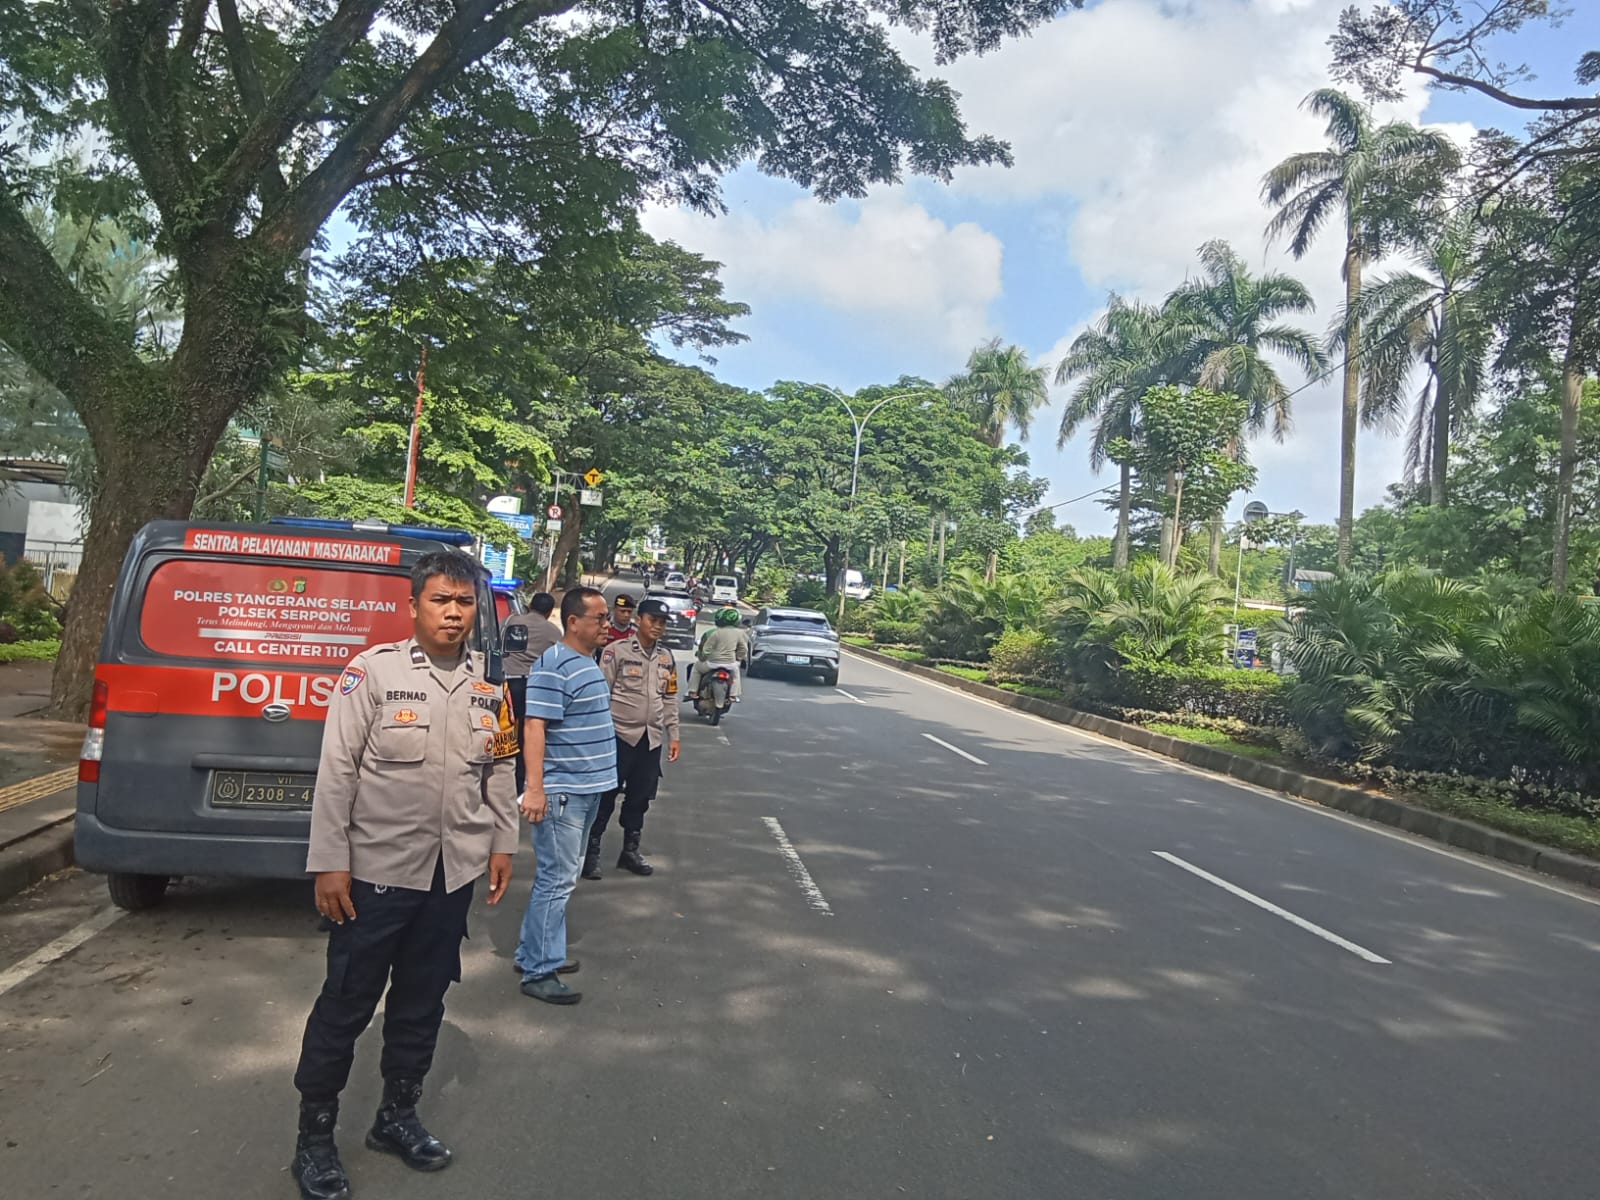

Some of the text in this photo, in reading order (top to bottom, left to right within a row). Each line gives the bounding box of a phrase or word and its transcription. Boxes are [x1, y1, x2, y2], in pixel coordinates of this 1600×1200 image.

[193, 533, 392, 563] SENTRA PELAYANAN MASYARAKAT
[174, 589, 397, 613] POLRES TANGERANG SELATAN
[218, 606, 351, 623] POLSEK SERPONG
[196, 616, 219, 625] Terus
[271, 620, 316, 631] Mengayomi
[317, 623, 333, 631] dan
[334, 624, 372, 633] Melayani
[213, 640, 349, 658] CALL CENTER 110
[211, 672, 336, 707] POLIS
[386, 690, 427, 702] BERNAD
[246, 787, 284, 801] 2308
